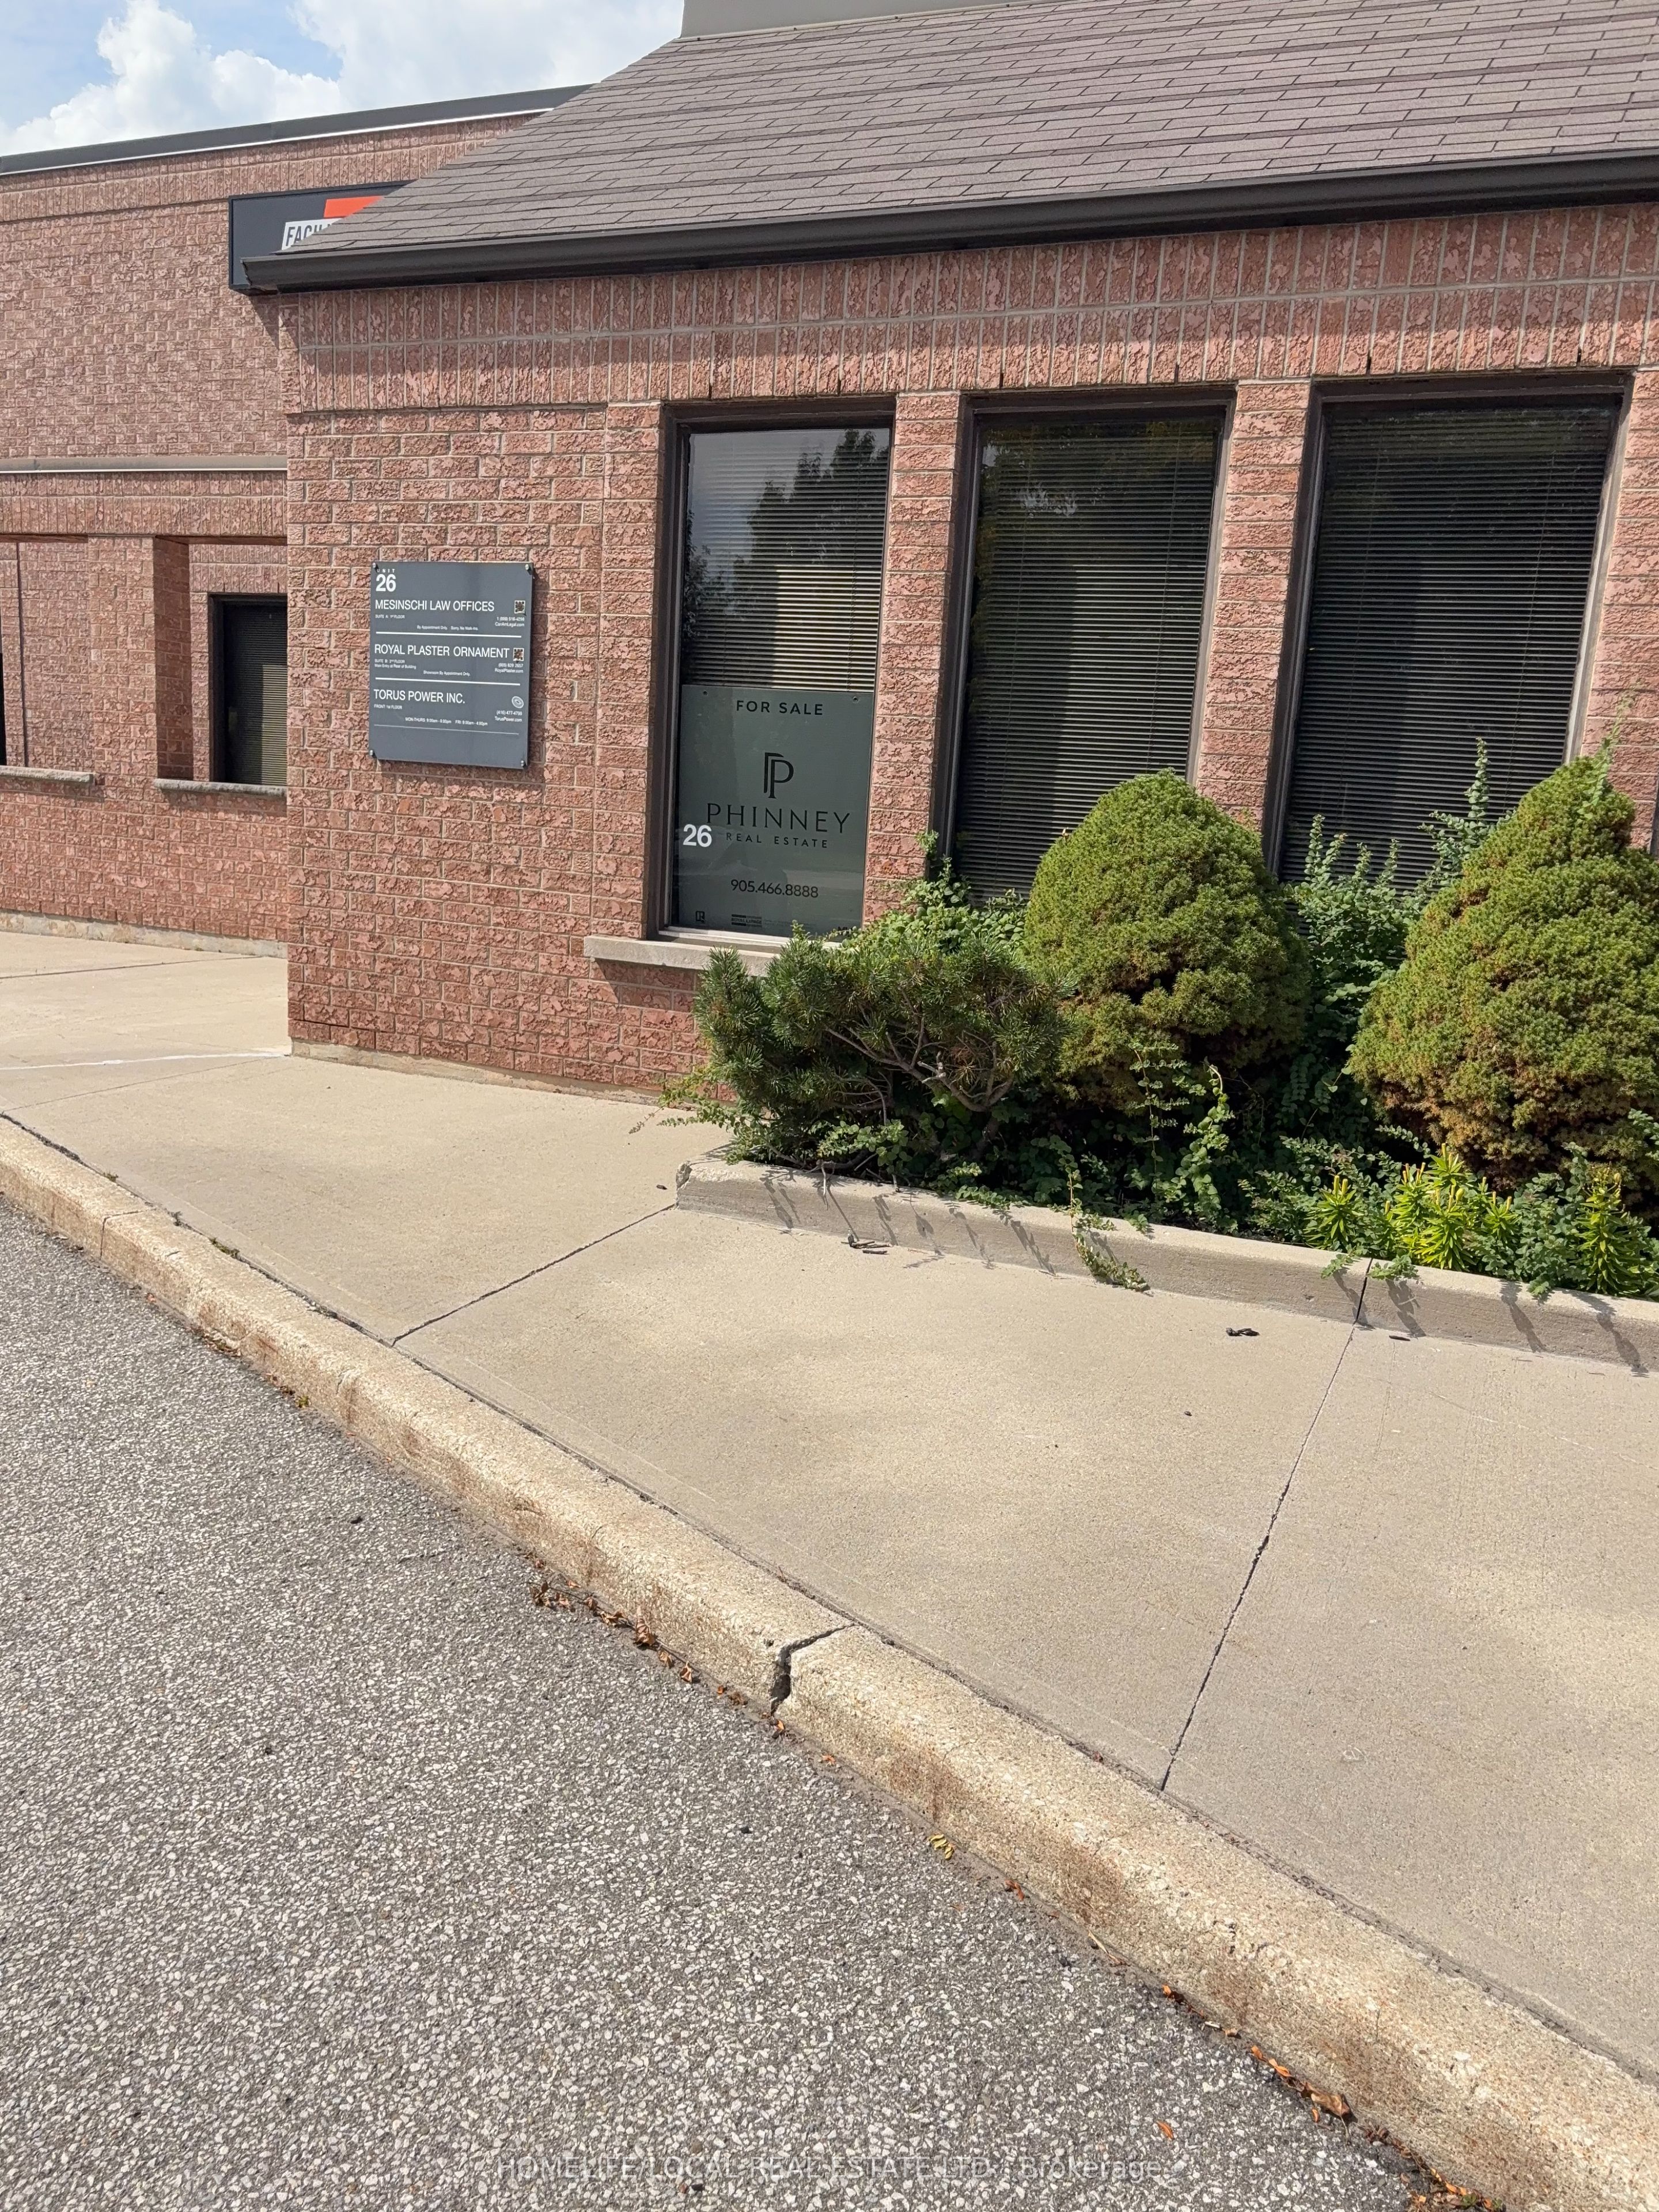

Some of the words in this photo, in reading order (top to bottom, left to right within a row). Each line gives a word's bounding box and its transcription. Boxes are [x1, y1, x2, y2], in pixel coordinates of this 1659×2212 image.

[376, 574, 396, 592] 26
[375, 600, 427, 610] MESINSCHI
[430, 600, 450, 611] LAW
[453, 601, 494, 612] OFFICES
[374, 644, 405, 655] ROYAL
[407, 645, 450, 656] PLASTER
[453, 646, 510, 658] ORNAMENT
[373, 689, 406, 700] TORUS
[408, 691, 444, 702] POWER
[446, 693, 465, 704] INC.
[736, 700, 770, 713] FOR
[779, 702, 823, 715] SALE
[707, 803, 850, 834] PHINNEY
[683, 824, 713, 847] 26
[726, 832, 762, 843] REAL
[774, 836, 828, 849] ESTATE
[730, 879, 819, 898] 905.466.8888
